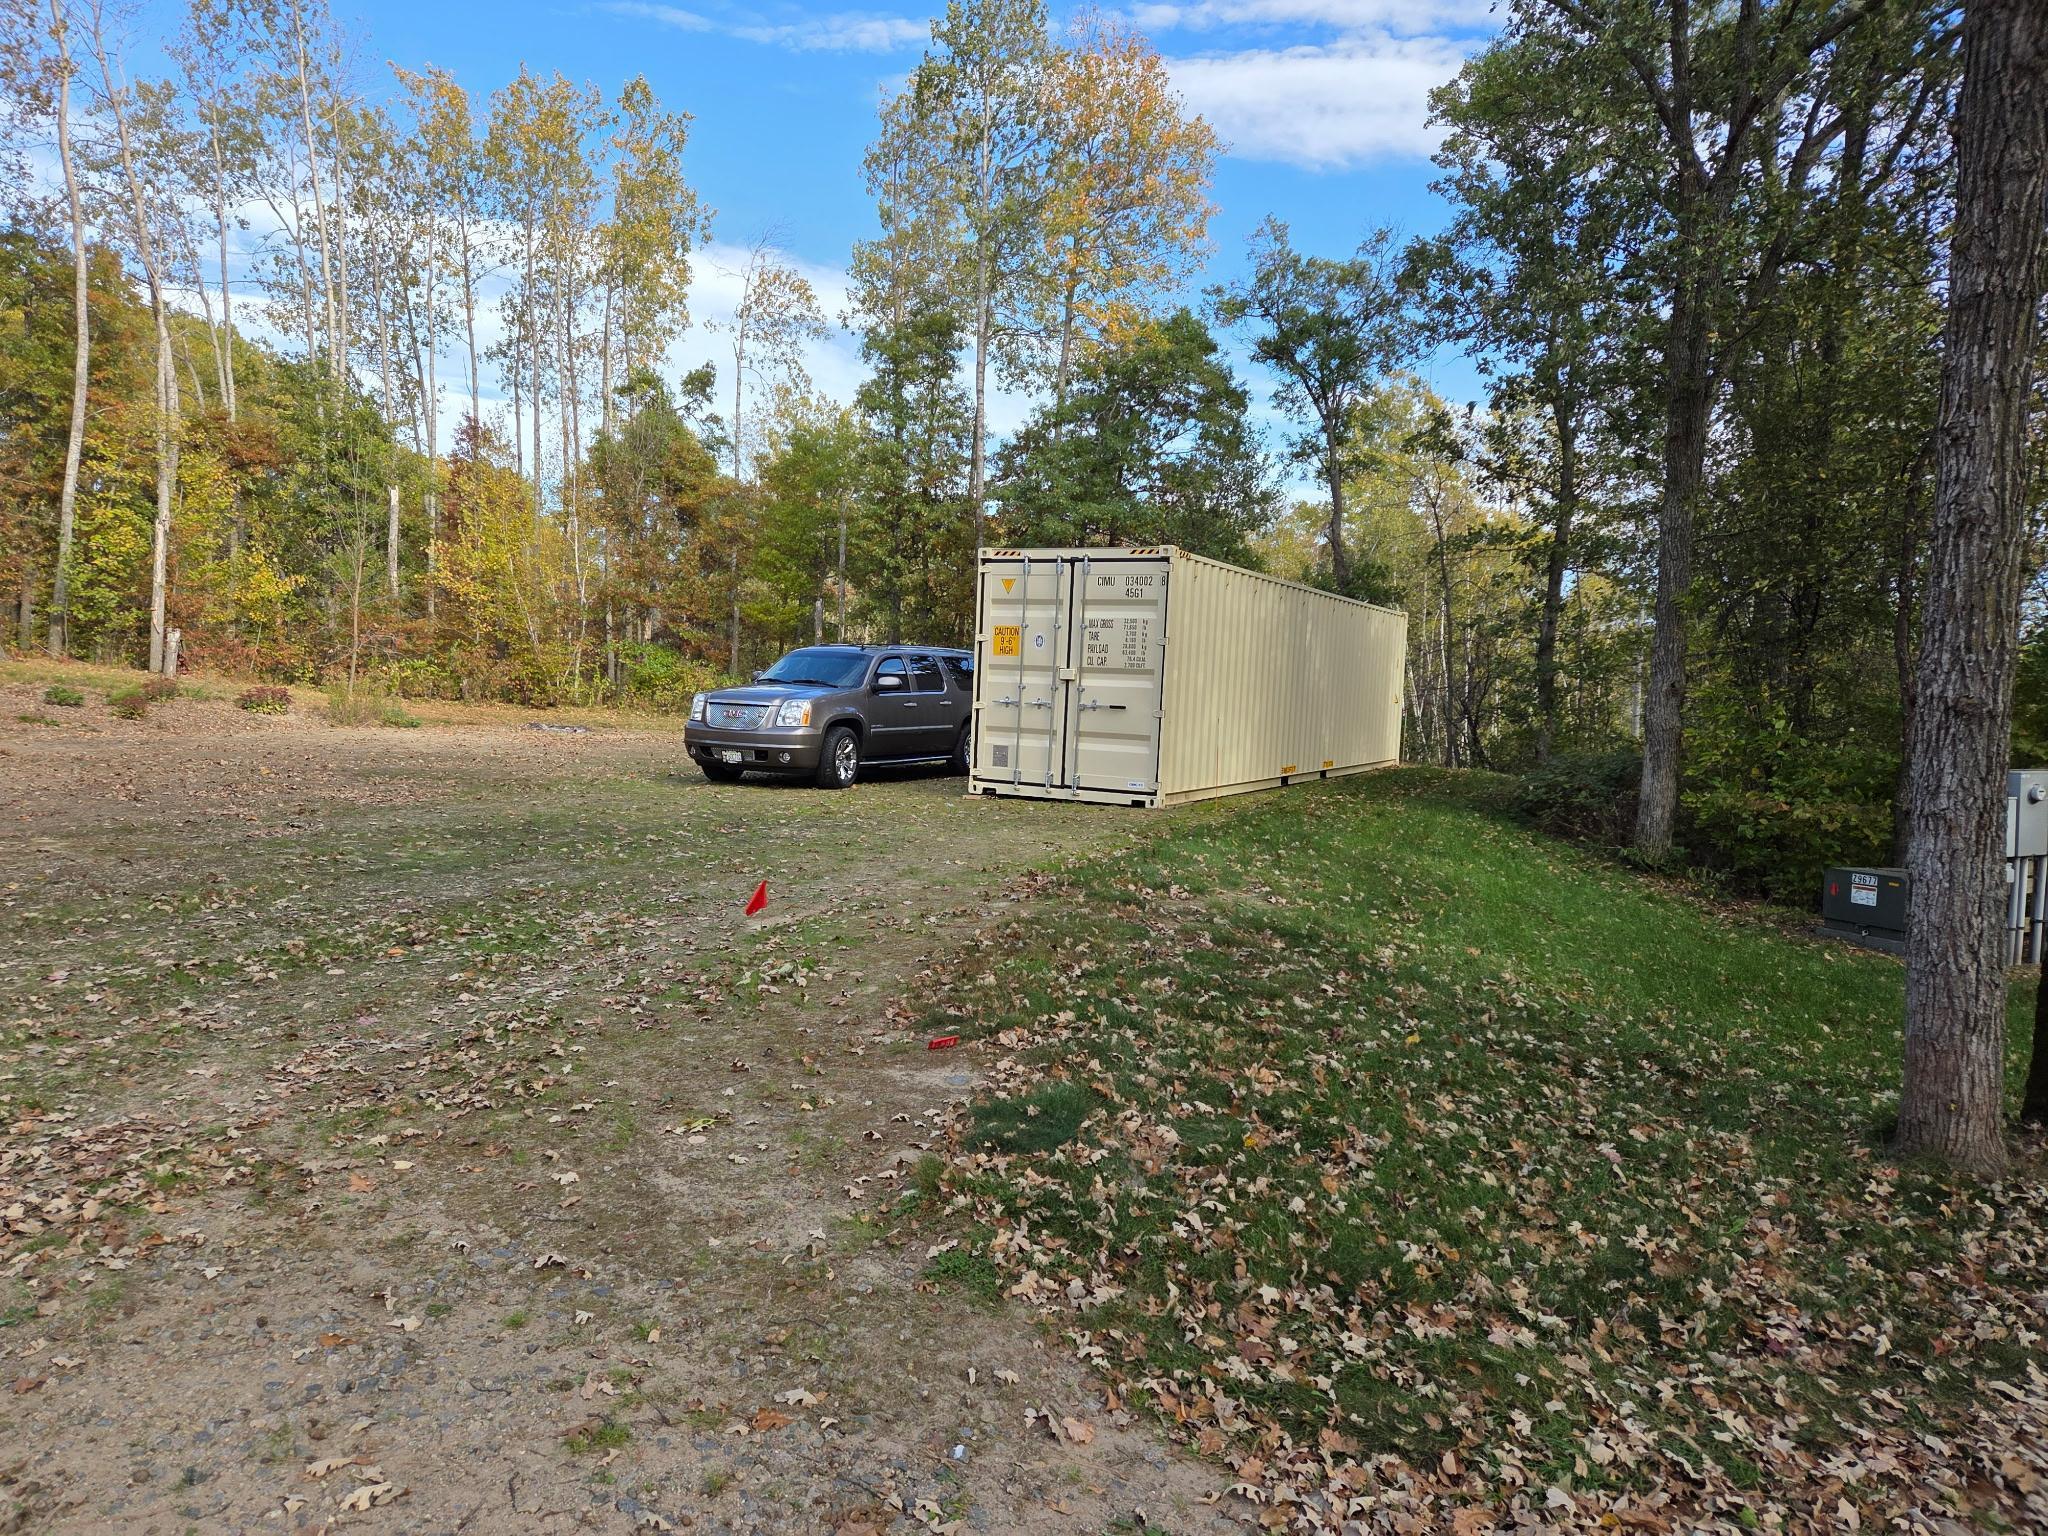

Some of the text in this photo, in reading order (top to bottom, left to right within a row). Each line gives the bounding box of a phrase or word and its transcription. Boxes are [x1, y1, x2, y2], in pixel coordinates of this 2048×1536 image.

[1097, 576, 1166, 586] CIMU 034002 8
[1125, 588, 1143, 598] 45G1
[1089, 618, 1099, 628] MAX
[1100, 618, 1114, 628] GROSS
[994, 627, 1019, 636] CAUTION
[1088, 631, 1100, 641] TARE
[999, 646, 1013, 655] HIGH
[1088, 643, 1108, 654] PAYLOAD
